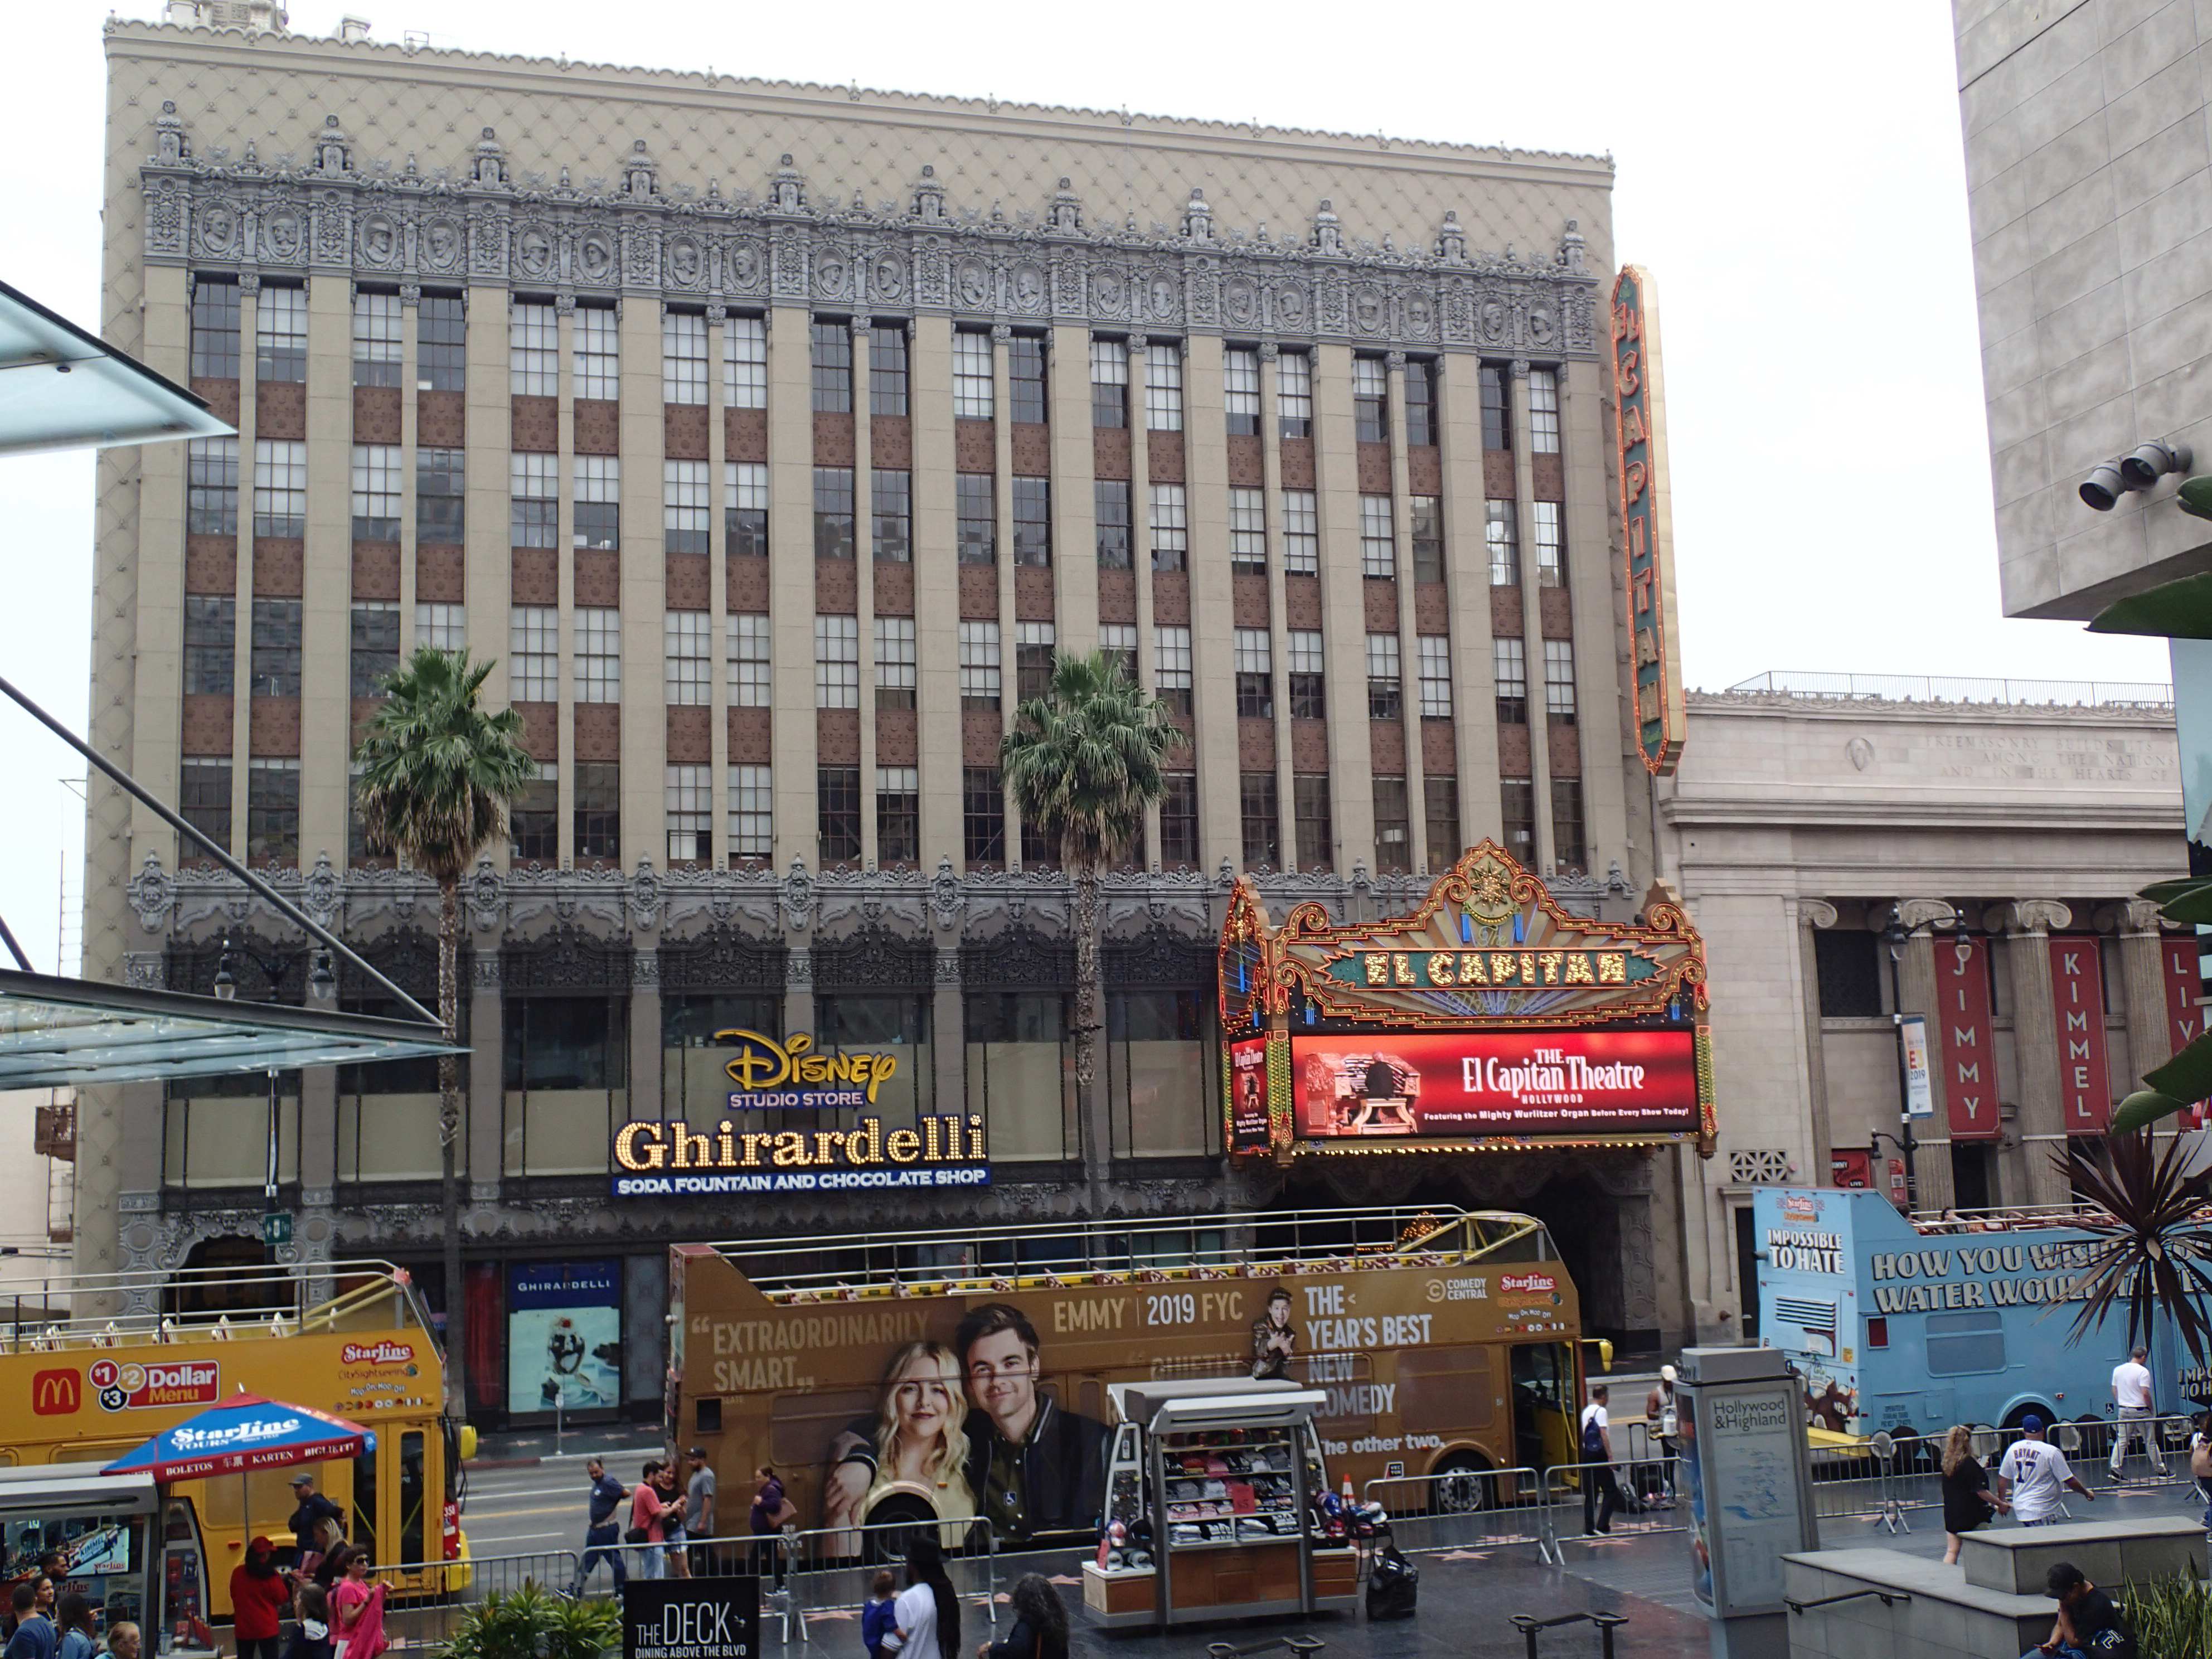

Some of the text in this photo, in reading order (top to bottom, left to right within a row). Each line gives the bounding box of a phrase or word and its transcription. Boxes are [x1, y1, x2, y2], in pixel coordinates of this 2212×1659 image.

[2056, 753, 2088, 765] THE
[1365, 951, 1626, 987] EL CAPITAN
[2173, 953, 2194, 1042] LIV
[2064, 953, 2092, 1117] KIMMEL
[1534, 1049, 1565, 1064] THE
[1462, 1056, 1645, 1098] El Capitan Theatre
[1910, 1070, 1926, 1080] 2019
[730, 1091, 863, 1108] STUDIO STORE
[1521, 1093, 1584, 1104] HOLLYWOOD
[1424, 1113, 1462, 1122] Featuring
[1479, 1109, 1512, 1120] Mighty
[1514, 1108, 1559, 1119] Wurlitzer
[1561, 1109, 1589, 1119] Organ
[1618, 1109, 1640, 1118] Every
[1663, 1107, 1689, 1117] Today!
[615, 1113, 987, 1171] Ghirardelli
[617, 1170, 986, 1195] SODA FOUNTAIN AND CHOCOLATE SHOP
[1767, 1229, 1844, 1249] IMPOSSIBLE
[1769, 1245, 1846, 1274] TO HATE
[1873, 1249, 1952, 1280] HOW
[1958, 1245, 2023, 1275] YOU
[1447, 1277, 1487, 1290] COMEDY
[1304, 1284, 1346, 1316] THE
[1447, 1288, 1488, 1301] CENTRAL
[1874, 1281, 1985, 1314] WATER
[1053, 1291, 1244, 1332] EMMY 2019 FYC
[1306, 1313, 1433, 1350] YEAR'S BEST
[148, 1366, 216, 1389] Dollar
[1308, 1352, 1355, 1383] NEW
[148, 1388, 199, 1404] Menu
[1713, 1396, 1785, 1417] Hollywood
[1352, 1436, 1403, 1453] other
[1405, 1434, 1446, 1449] two.
[252, 1451, 294, 1464] KARTEN
[2013, 1448, 2041, 1461] BRYANT
[166, 1461, 214, 1476] BOLETOS
[2015, 1461, 2036, 1483] 17
[636, 1602, 732, 1646] THE DECK
[635, 1644, 746, 1659] DINING ABOVE THE BLVD
